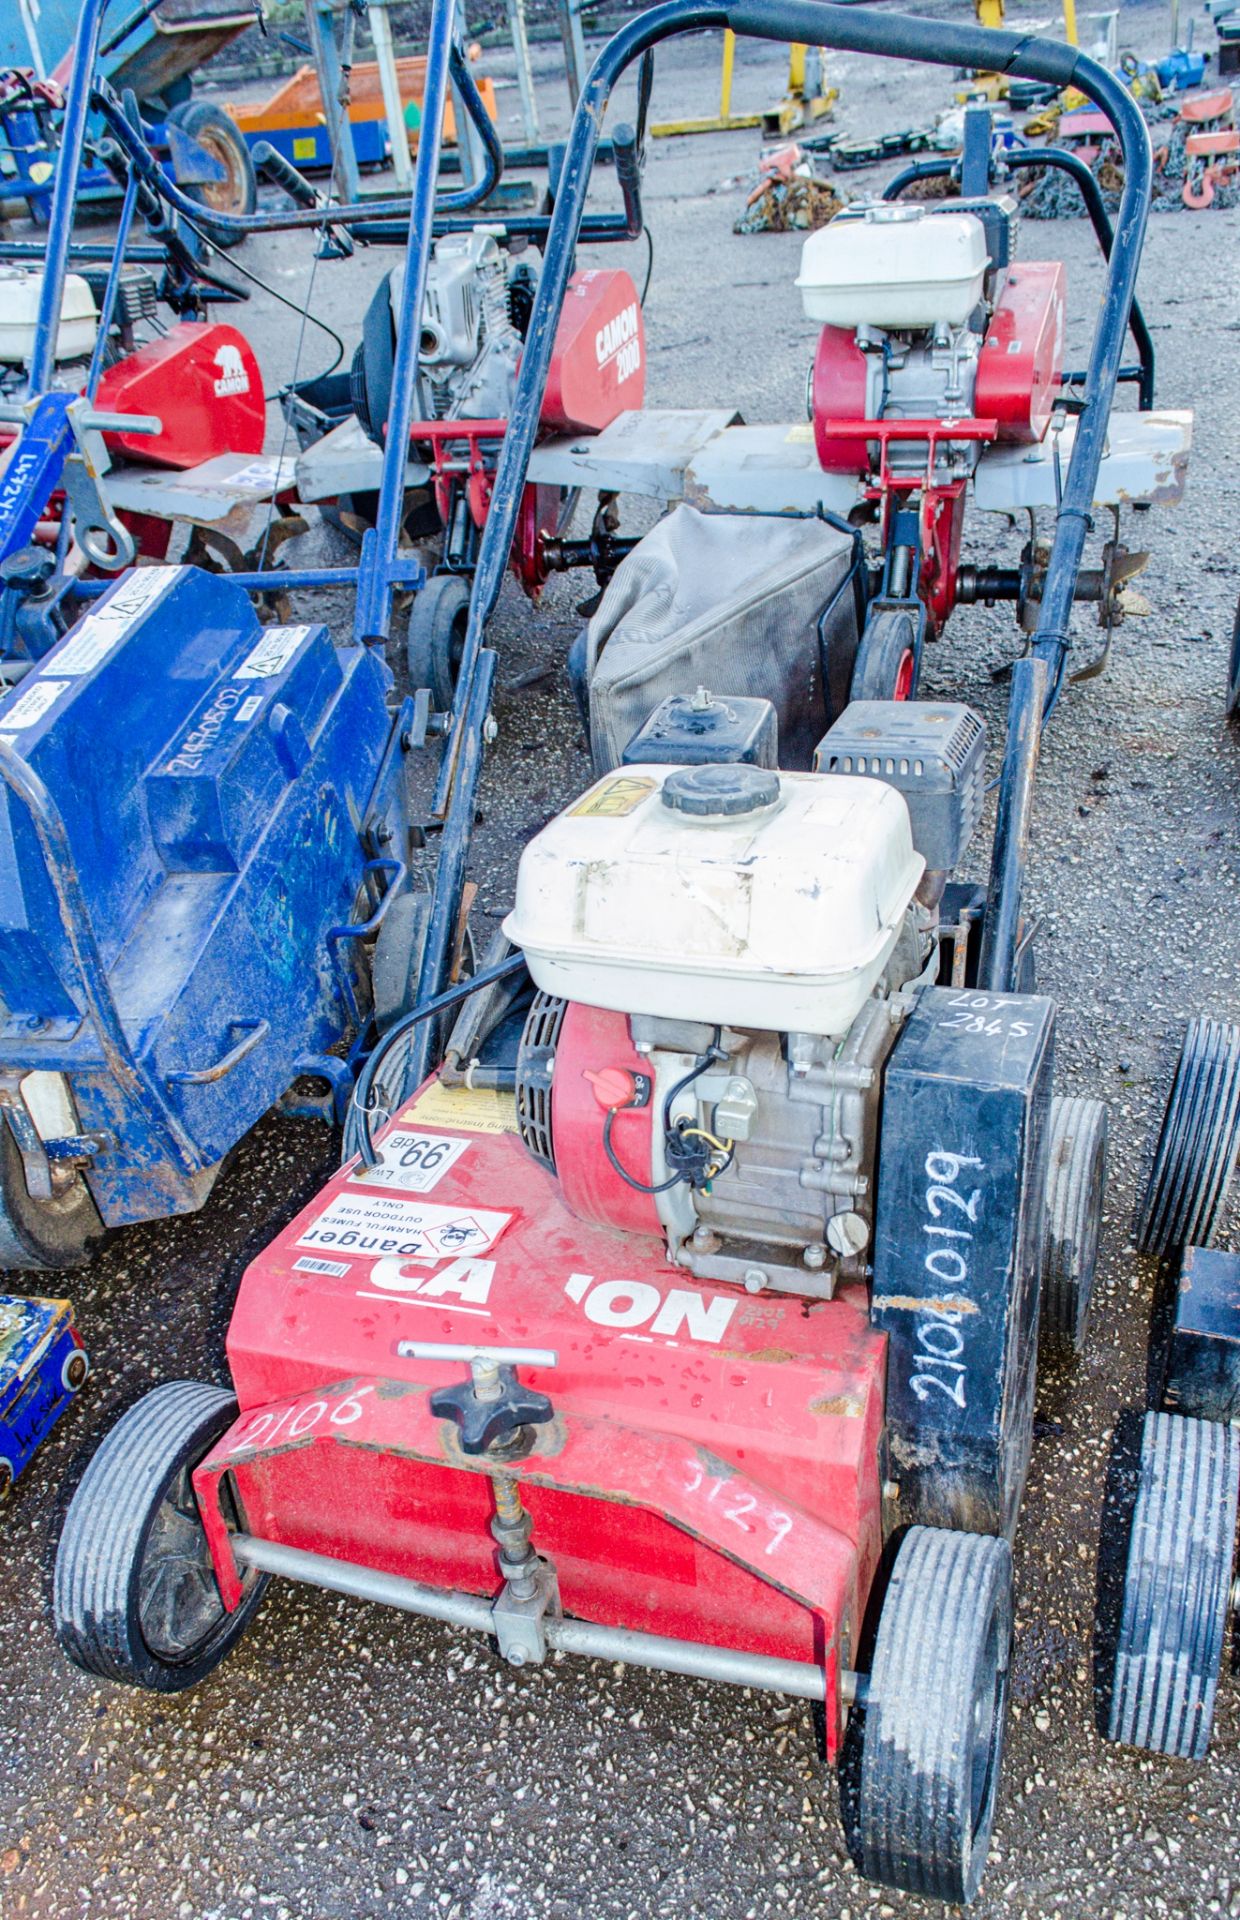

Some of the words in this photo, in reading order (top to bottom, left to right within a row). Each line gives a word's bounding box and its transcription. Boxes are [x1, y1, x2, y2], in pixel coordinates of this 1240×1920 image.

[595, 302, 639, 363] CAMON
[616, 339, 641, 385] 2000
[213, 375, 250, 398] CAMON
[947, 992, 1023, 1011] LOT
[938, 1012, 1035, 1037] 2845
[338, 1207, 363, 1217] USE
[373, 1200, 404, 1209] ONLY
[321, 1216, 363, 1227] FUMES
[365, 1210, 423, 1224] OUTDOOR
[365, 1221, 422, 1235] HARMFUL
[303, 1229, 422, 1255] Danger
[229, 1385, 375, 1453] 2106
